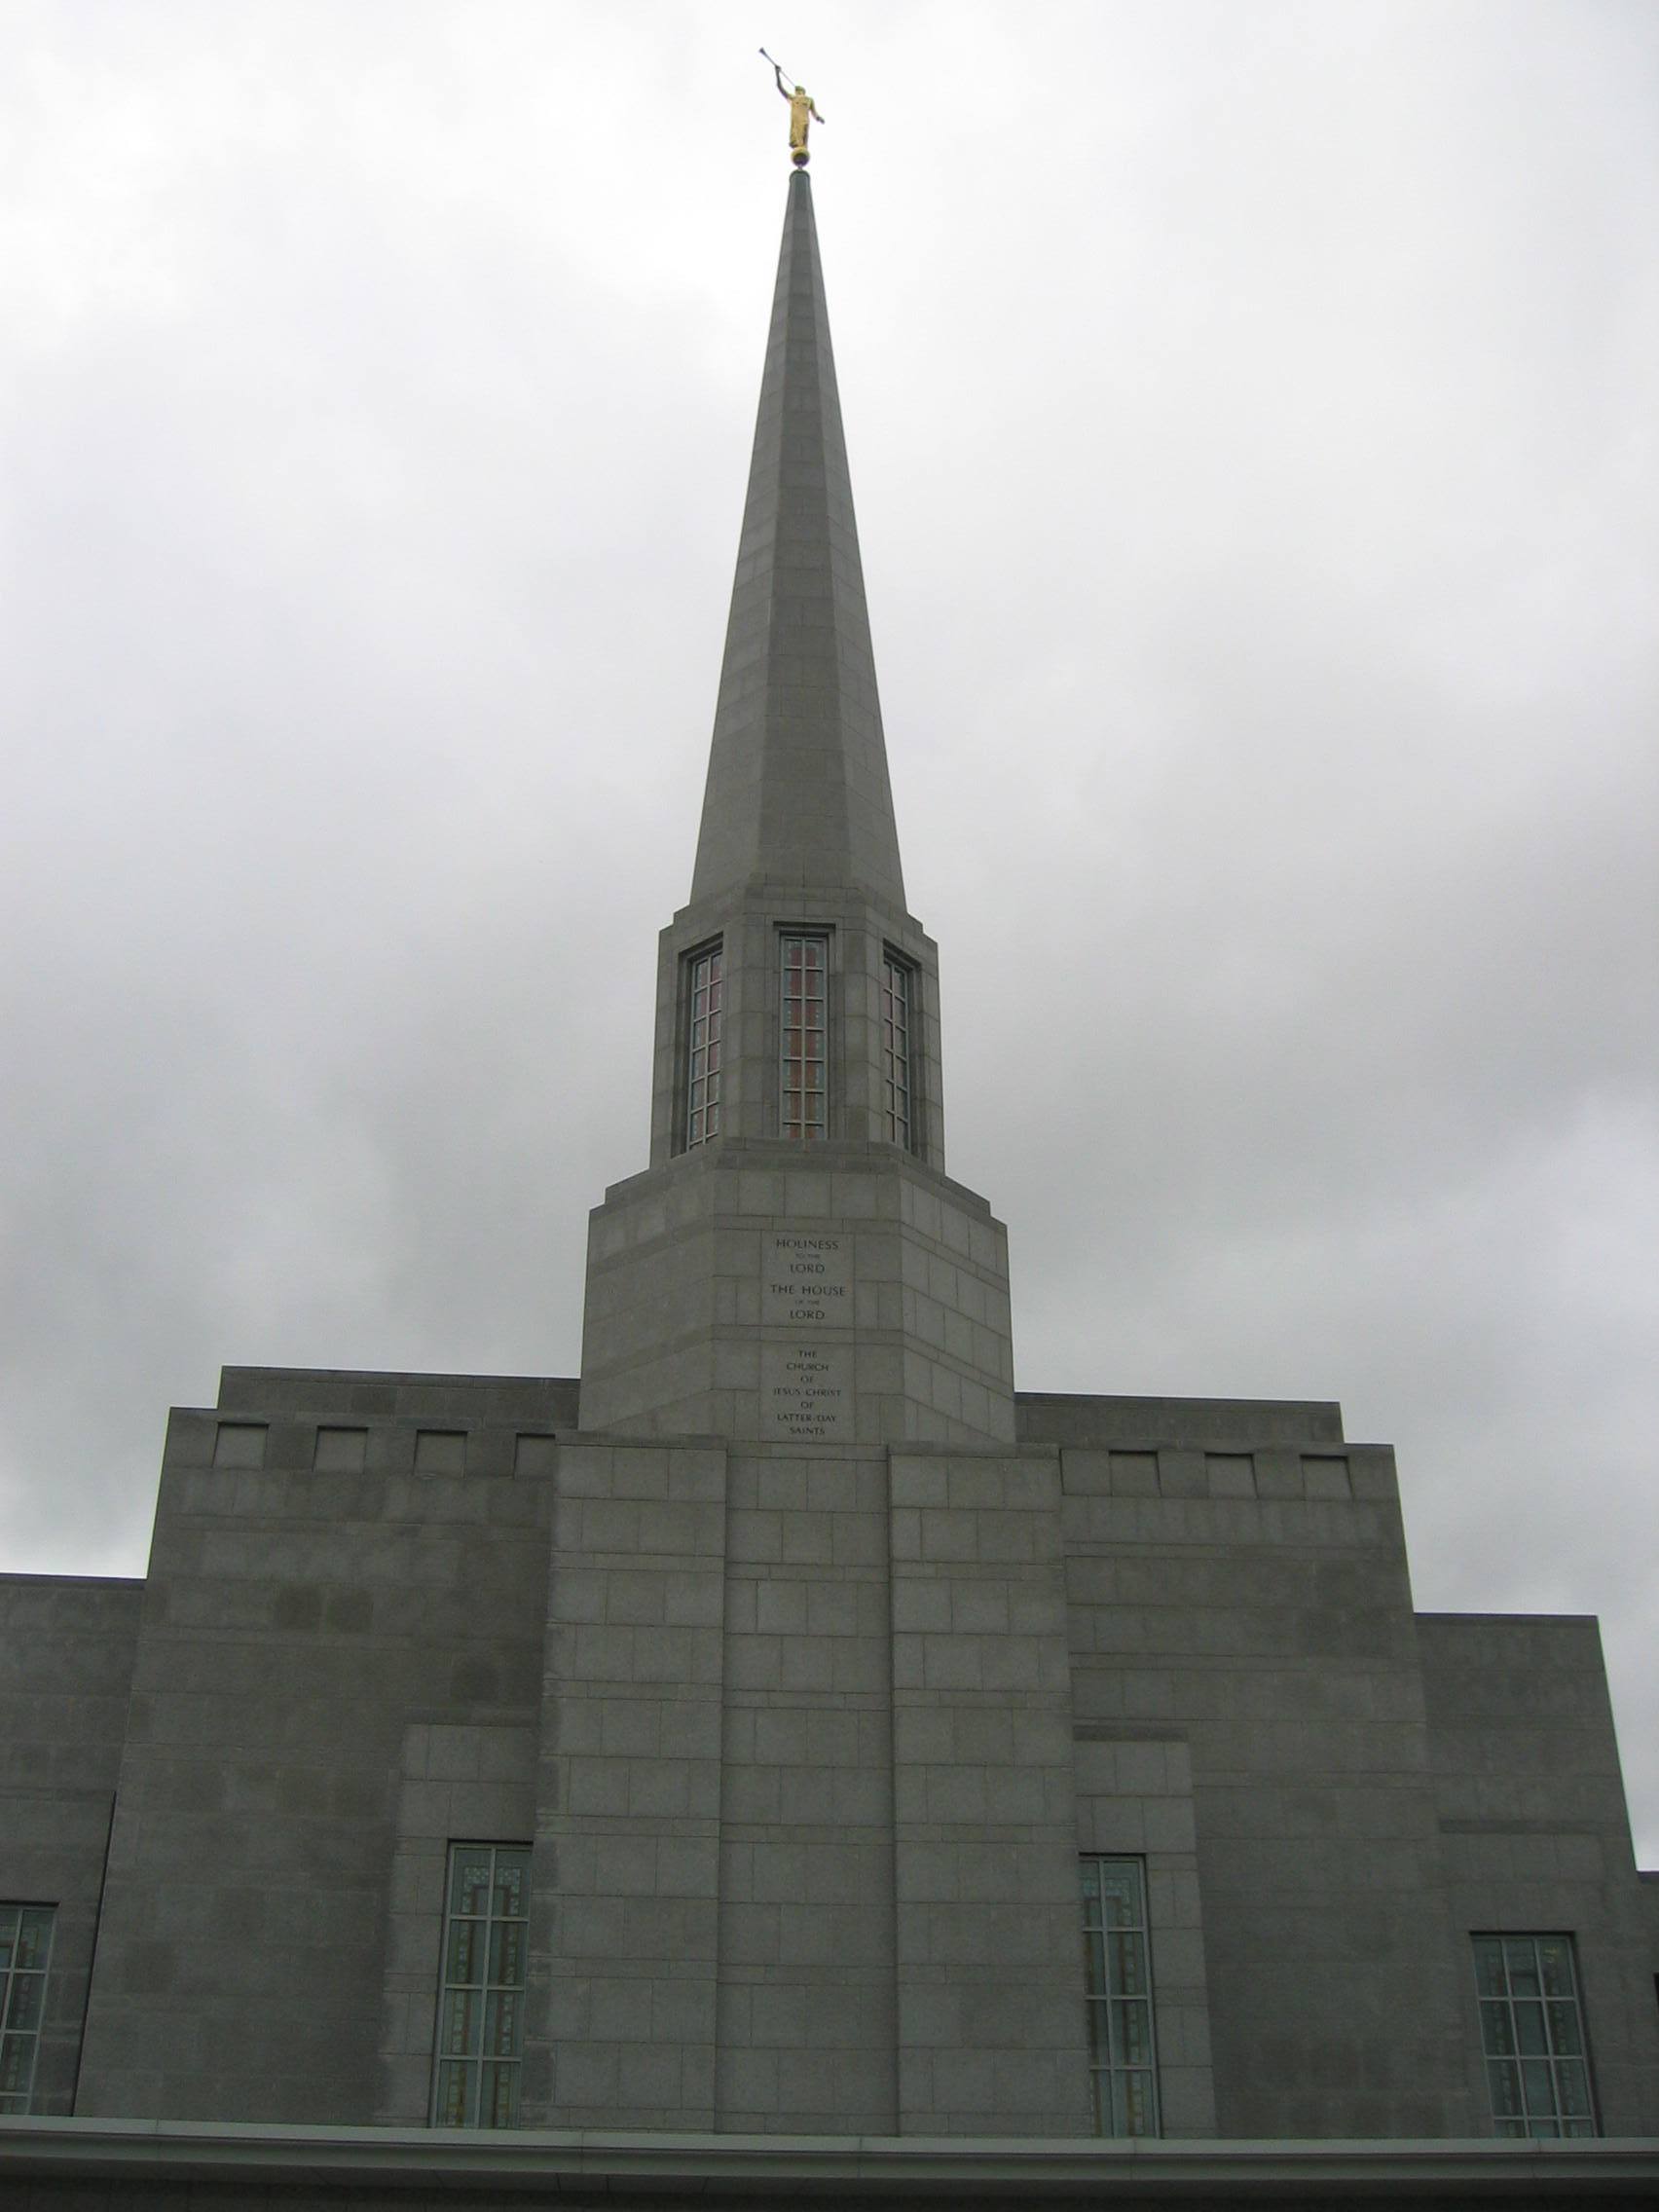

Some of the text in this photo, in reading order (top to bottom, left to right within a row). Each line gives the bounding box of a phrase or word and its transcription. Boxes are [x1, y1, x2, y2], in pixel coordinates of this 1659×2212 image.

[776, 1238, 839, 1250] HOLINESS
[790, 1264, 826, 1273] LORD
[770, 1284, 847, 1297] THE HOUSE
[790, 1310, 826, 1320] LORD
[798, 1349, 818, 1358] THE
[787, 1362, 830, 1372] CHURCH
[773, 1387, 842, 1397] JESUS CHRIST
[789, 1426, 826, 1435] SAINTS
